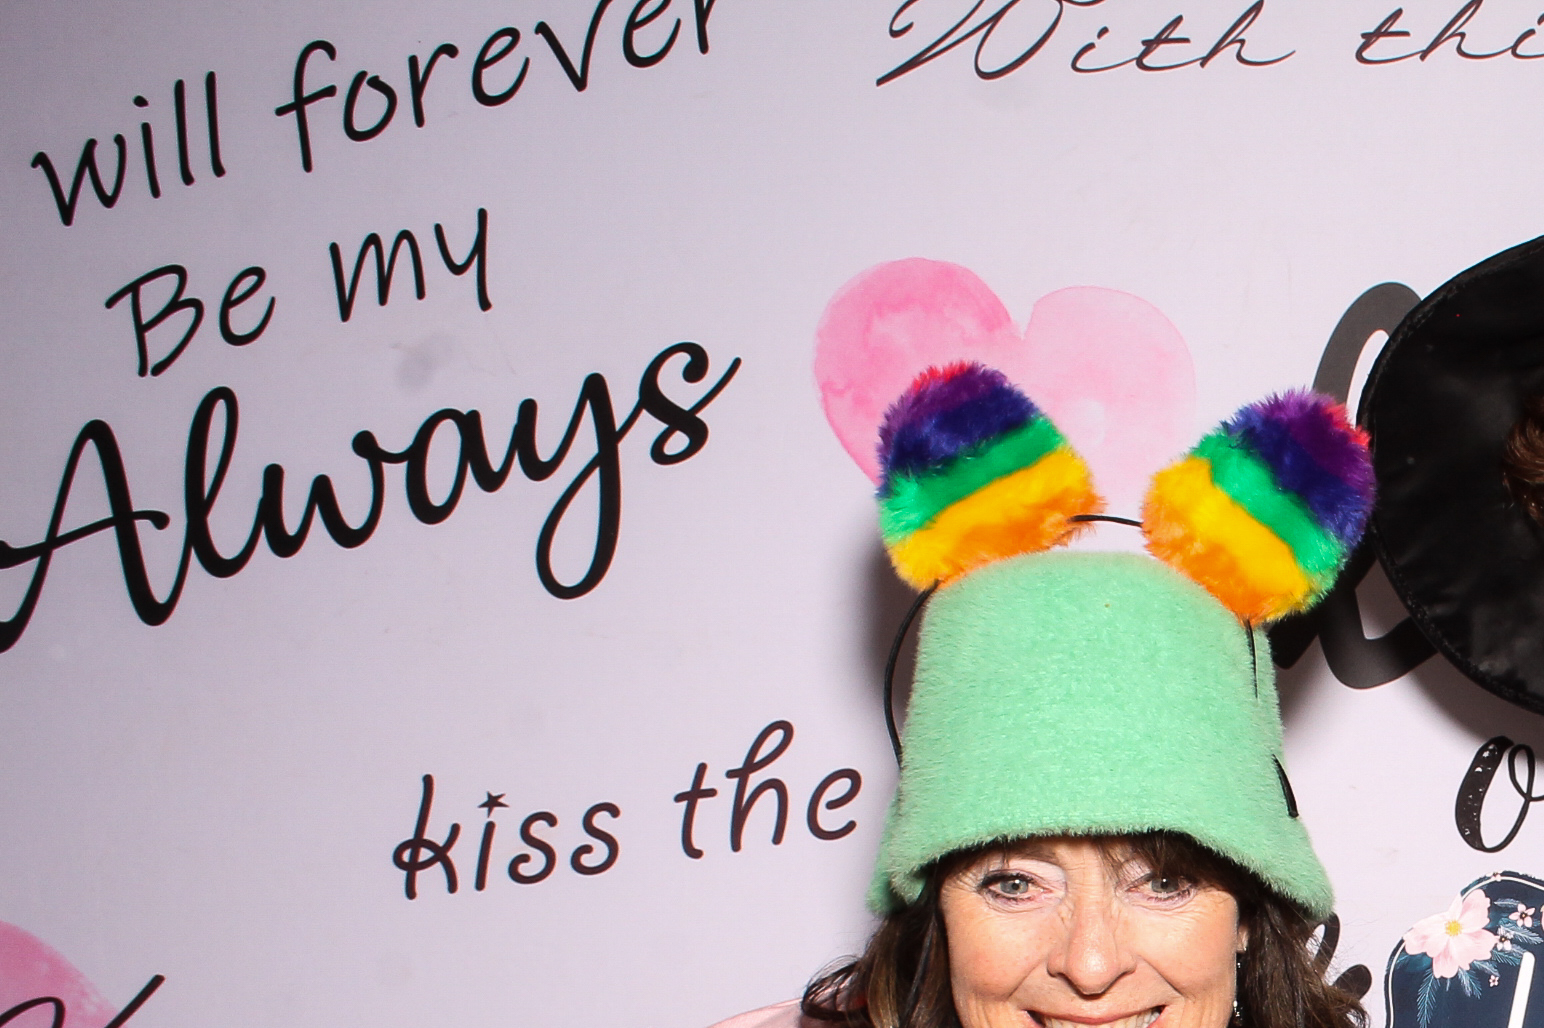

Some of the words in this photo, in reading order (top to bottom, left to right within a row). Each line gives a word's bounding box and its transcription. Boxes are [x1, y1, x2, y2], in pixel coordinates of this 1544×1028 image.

[31, 70, 225, 226] will
[274, 0, 718, 173] forever
[876, 0, 1296, 87] With
[105, 264, 275, 378] Be
[330, 208, 492, 323] my
[0, 342, 742, 653] Always
[392, 774, 620, 900] kiss
[673, 720, 862, 860] the
